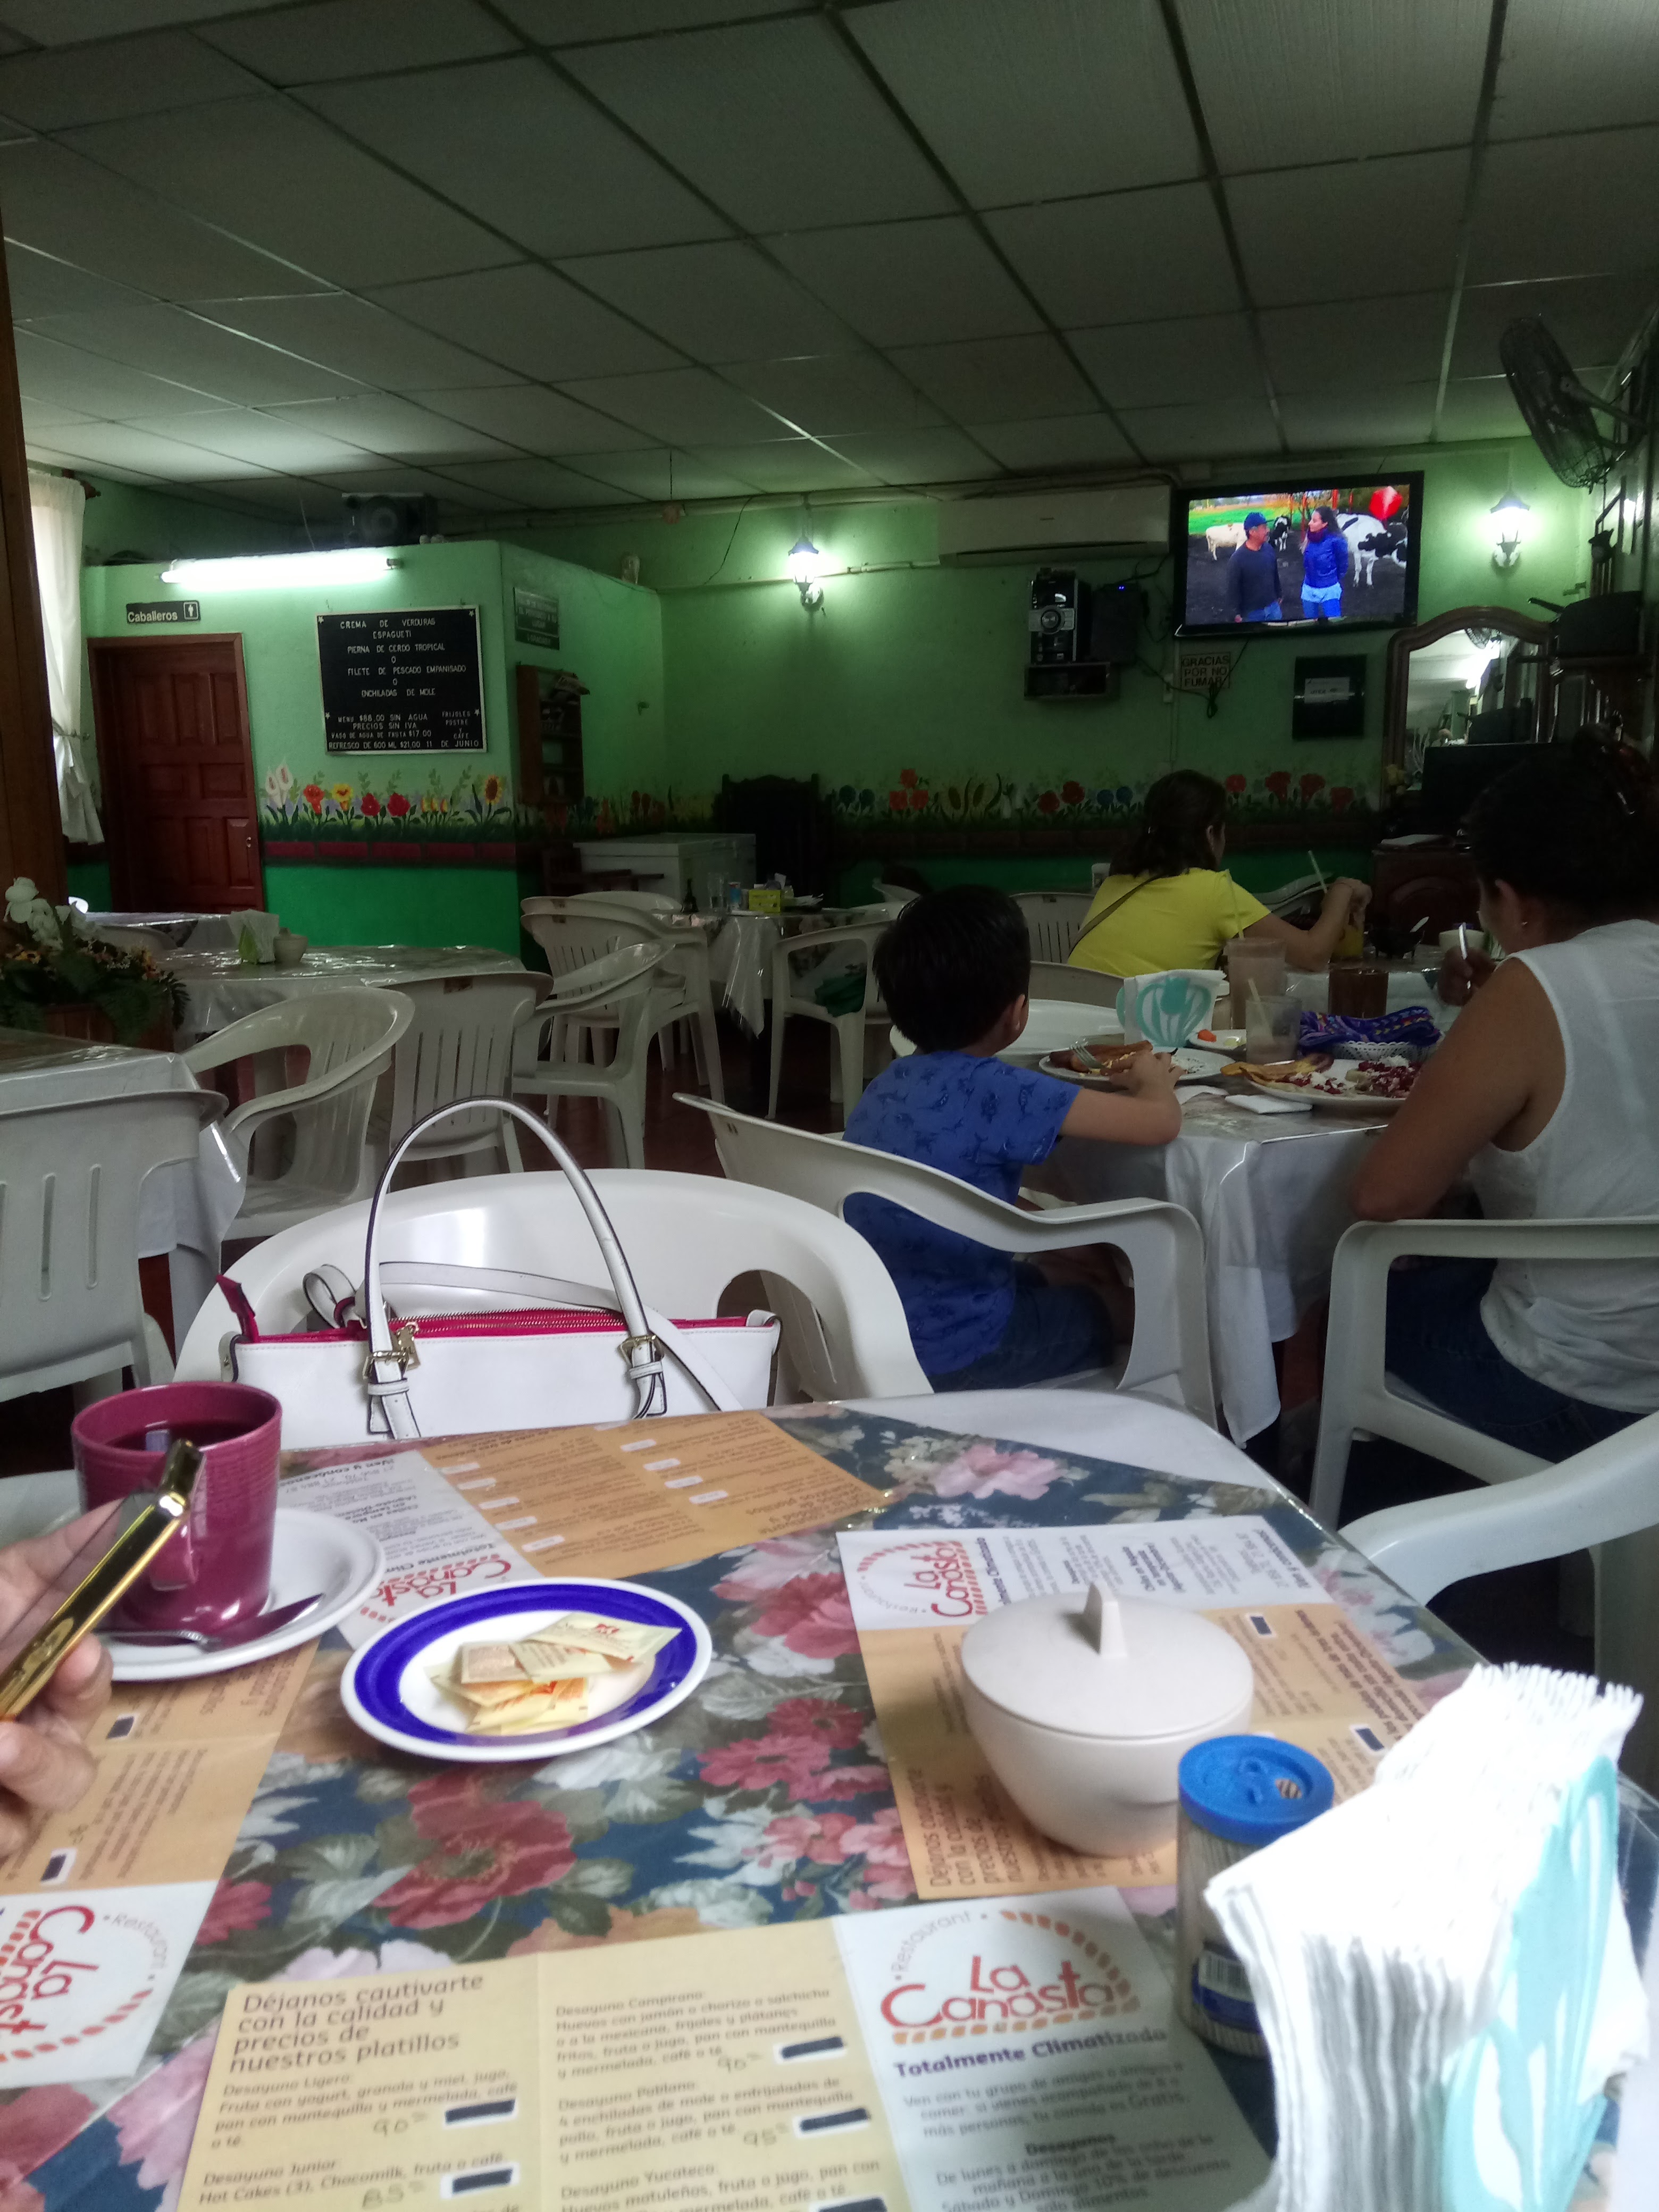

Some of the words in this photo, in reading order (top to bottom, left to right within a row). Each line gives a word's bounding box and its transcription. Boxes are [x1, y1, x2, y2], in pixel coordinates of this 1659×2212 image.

[128, 610, 178, 622] Caballeros
[340, 621, 366, 629] CREMA
[402, 617, 435, 626] VERDURAS
[347, 646, 370, 654] PIERNA
[389, 644, 410, 652] CERDO
[415, 642, 445, 651] TROPICAL
[373, 630, 411, 639] ESPAGUETI
[348, 667, 370, 676] FILETE
[378, 667, 386, 675] DE
[393, 666, 422, 675] PESCADO
[426, 665, 466, 674] EMPANISADO
[1182, 655, 1230, 666] GRACIAS
[1185, 668, 1206, 676] POR
[1212, 666, 1227, 676] NO
[329, 741, 359, 750] REFRESCO
[910, 1547, 973, 1618] Canasta
[31, 1959, 99, 2000] La
[970, 1955, 1032, 1994] La
[243, 1990, 347, 2014] Déjanos
[356, 1974, 484, 2004] cautivarte
[881, 1959, 1116, 2028] Canasta
[239, 2016, 284, 2033] con
[295, 2010, 317, 2028] la
[328, 1998, 419, 2025] calidad
[429, 1998, 444, 2017] y
[230, 2048, 346, 2074] nuestros
[357, 2031, 461, 2065] platillos
[234, 2030, 329, 2057] precios
[339, 2023, 370, 2044] de
[893, 2048, 1025, 2079] Totalmente
[1031, 2027, 1167, 2057] Climatizado
